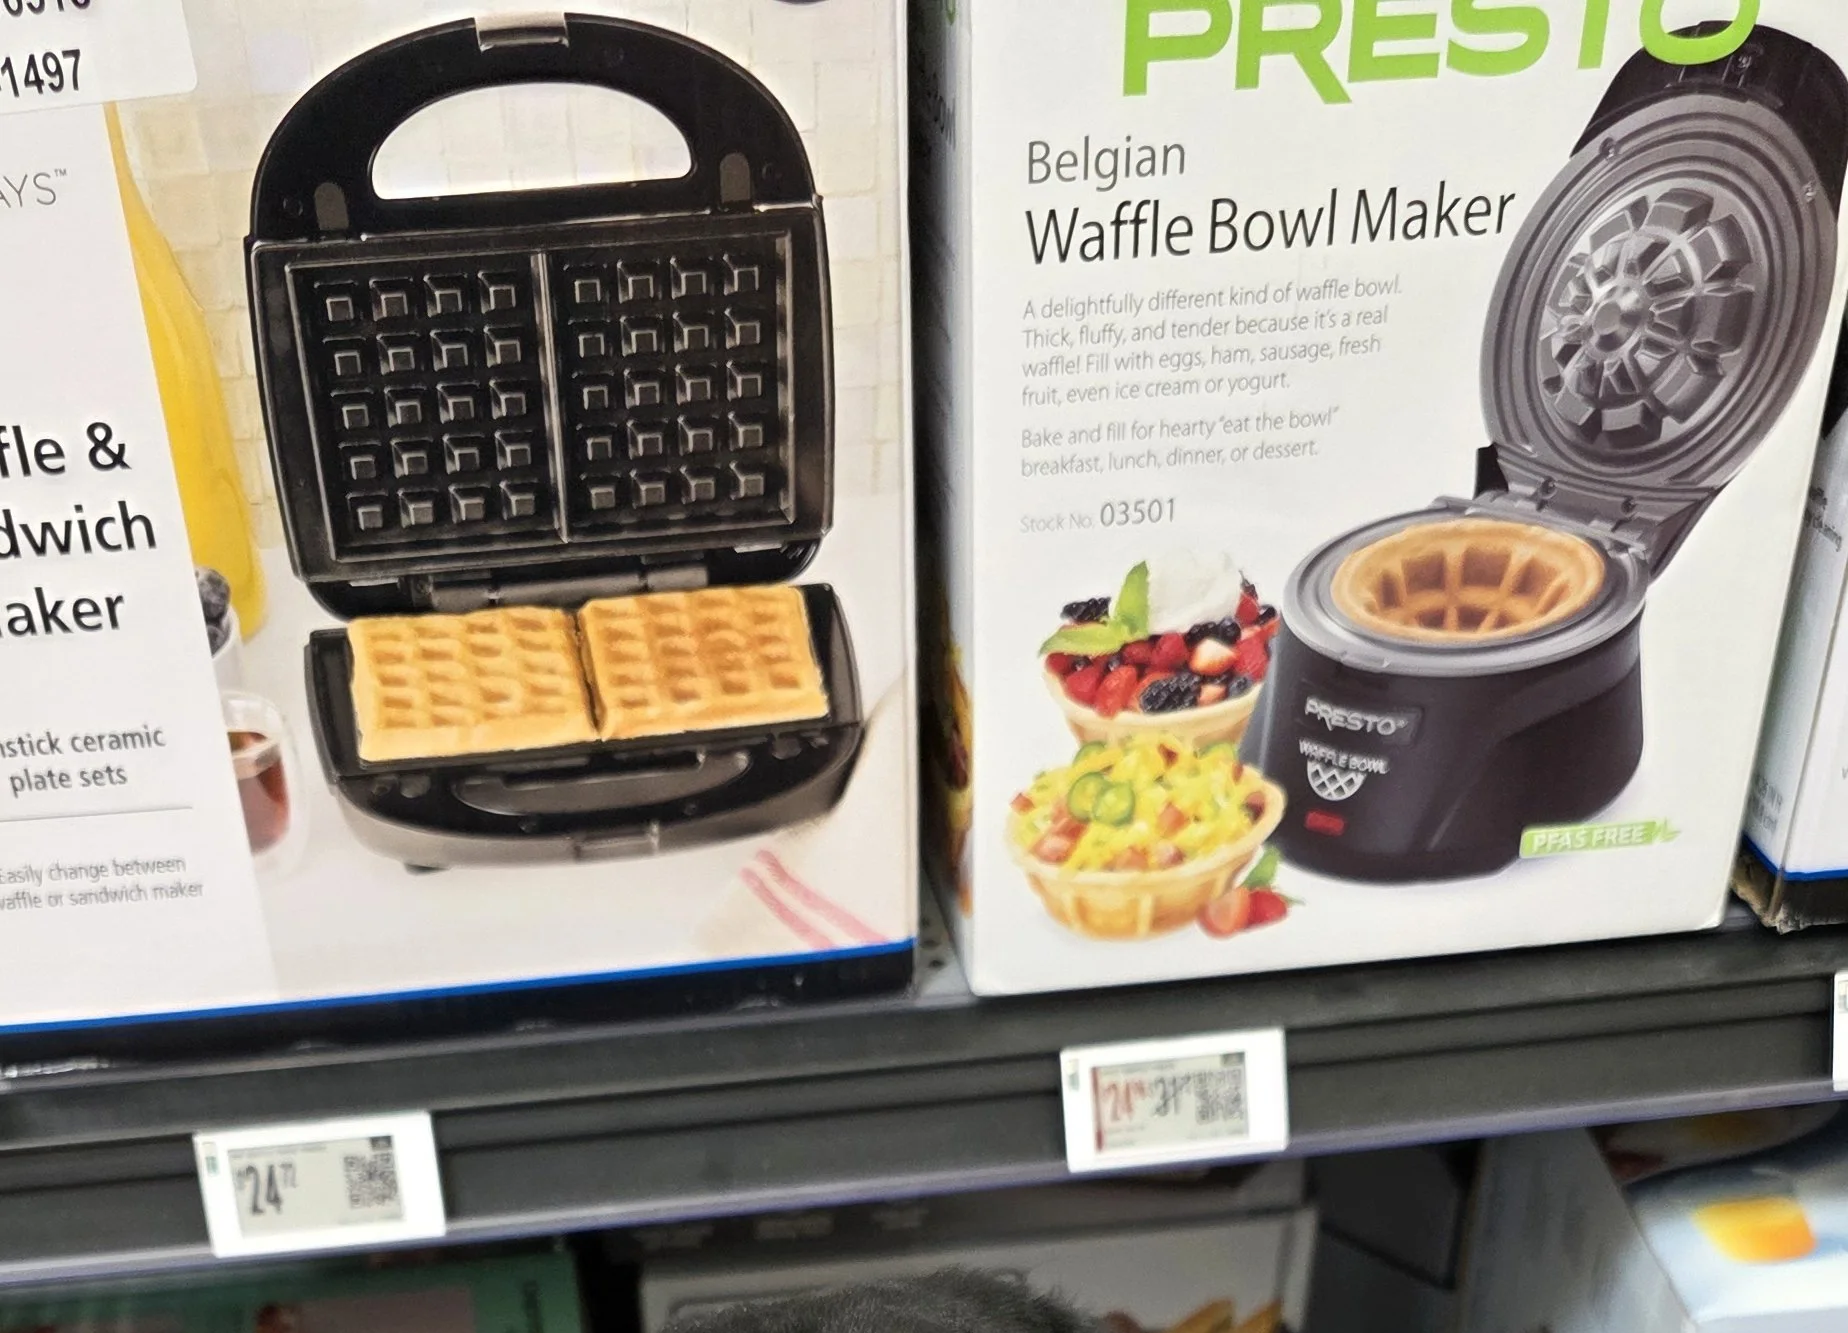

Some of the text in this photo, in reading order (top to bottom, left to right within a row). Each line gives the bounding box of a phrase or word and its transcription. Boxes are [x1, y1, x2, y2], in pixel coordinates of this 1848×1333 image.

[1123, 0, 1760, 104] PRESTO
[0, 49, 81, 98] 1497
[1028, 135, 1186, 192] Belgian
[1025, 180, 1516, 265] Waffle Bowl Maker
[1022, 273, 1402, 321] A delightfully different kind of waffle bowl.
[1022, 305, 1389, 349] Thick, fluffy, and tender because it's a real
[1022, 334, 1381, 377] waffle! Fill with eggs, ham, sausage, fresh
[1022, 372, 1291, 407] fruit, even ice cream or yogurt.
[86, 421, 132, 472] &
[1021, 428, 1063, 449] Bake
[1067, 424, 1102, 444] and
[1107, 421, 1126, 442] fill
[1131, 420, 1156, 441] for
[1160, 417, 1217, 441] hearty
[1255, 413, 1284, 432] the
[1021, 440, 1319, 478] breakfast, lunch, dinner, or dessert.
[1020, 512, 1064, 533] Stock
[1100, 497, 1176, 527] 03501
[0, 587, 124, 638] aker
[70, 722, 167, 754] ceramic
[9, 765, 128, 798] plate sets
[1532, 825, 1645, 852] PFAS FREE
[48, 861, 109, 883] change
[112, 856, 187, 878] between
[48, 892, 64, 908] or
[70, 883, 148, 907] sandwich
[152, 881, 204, 901] maker
